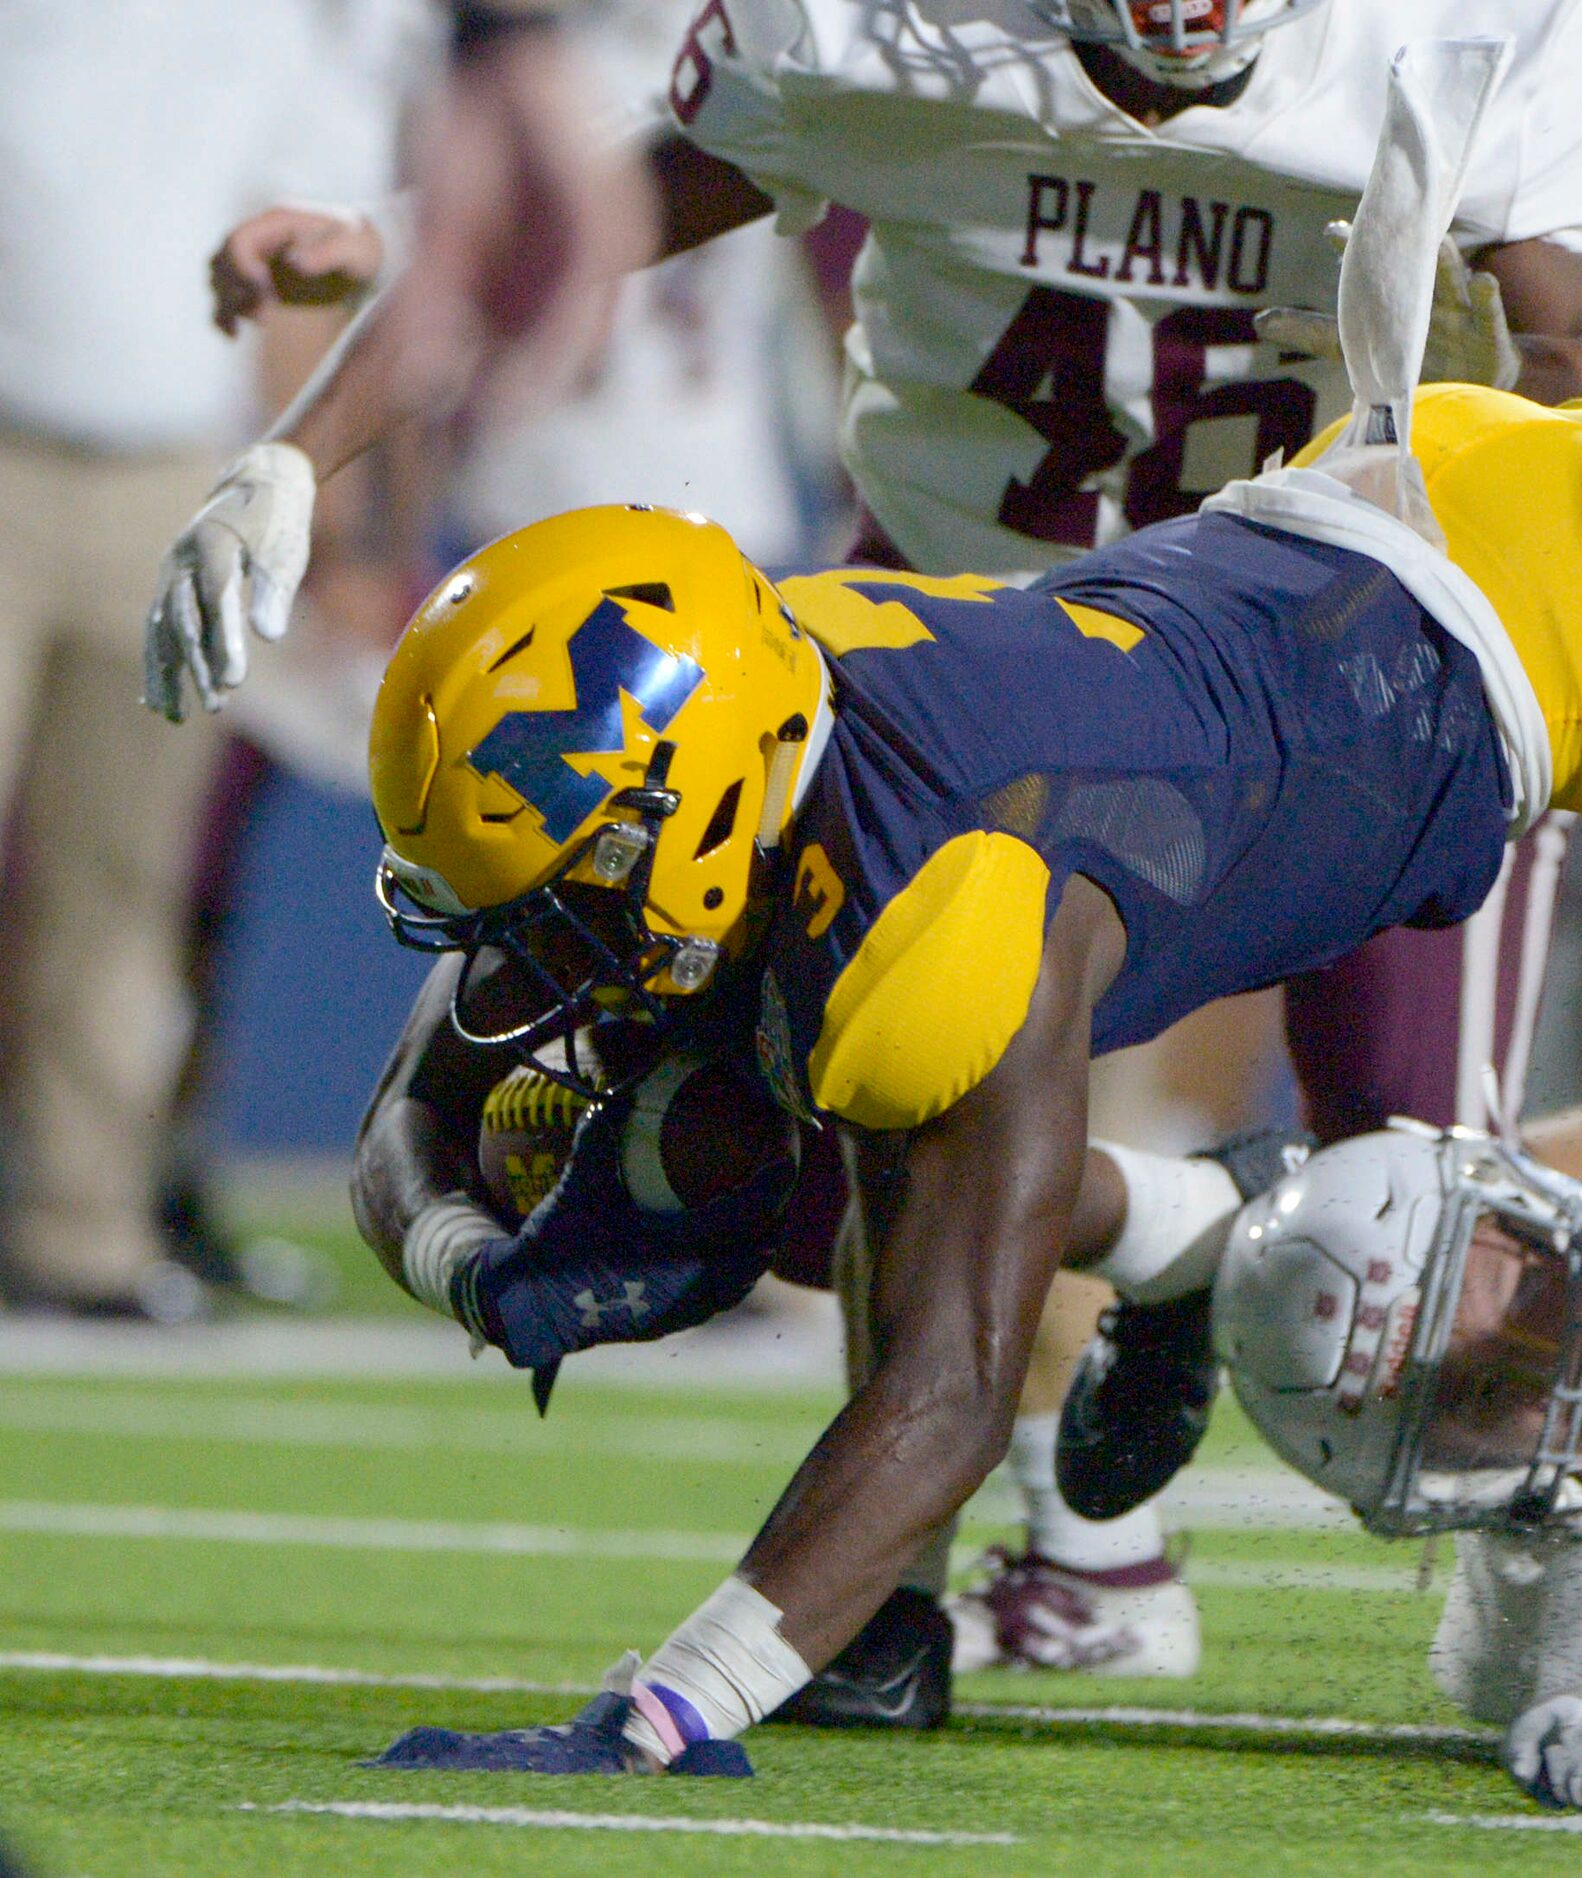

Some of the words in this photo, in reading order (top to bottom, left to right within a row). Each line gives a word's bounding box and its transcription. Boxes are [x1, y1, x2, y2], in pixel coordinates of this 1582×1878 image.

[1020, 173, 1274, 294] PLANO
[969, 285, 1317, 548] 46
[794, 842, 847, 940] 3
